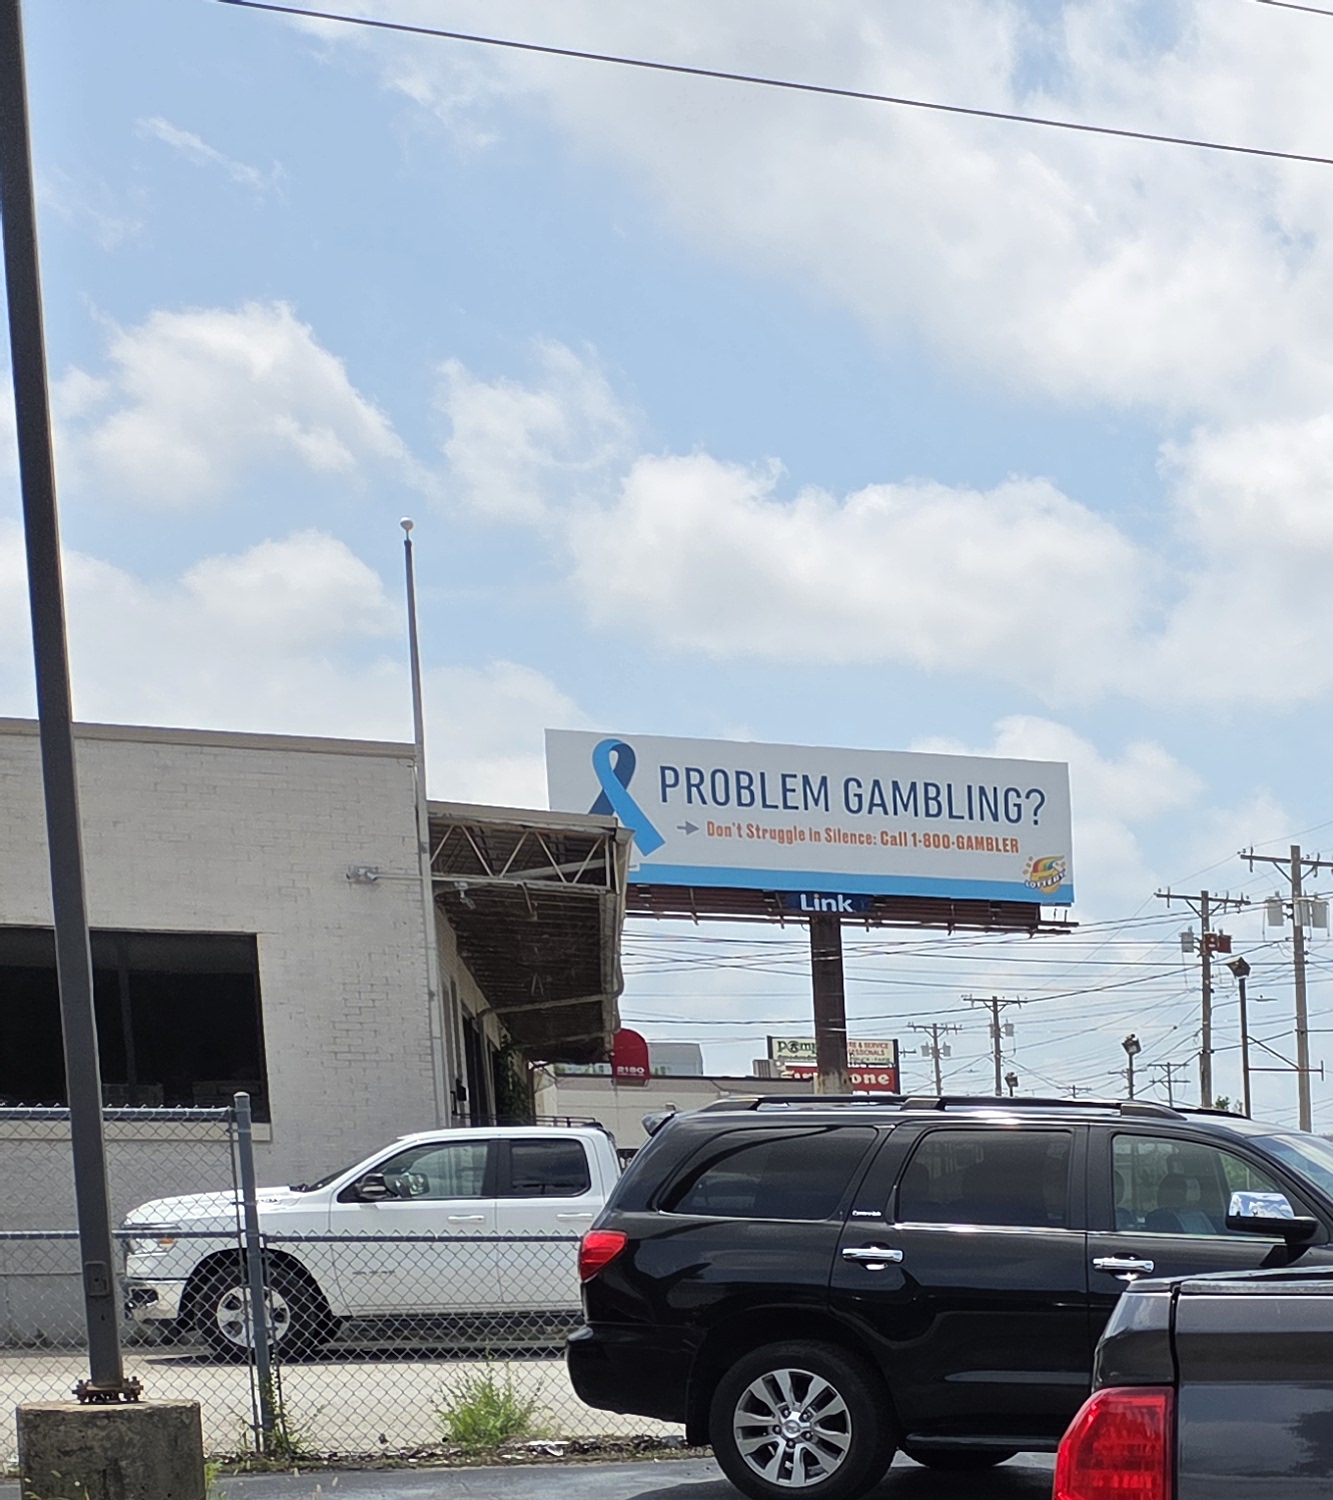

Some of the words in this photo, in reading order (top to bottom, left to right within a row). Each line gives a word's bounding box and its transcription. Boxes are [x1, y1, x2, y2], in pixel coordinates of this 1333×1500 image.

[659, 765, 830, 812] PROBLEM
[843, 777, 1046, 826] GAMBLING?
[707, 821, 743, 838] Don't
[746, 823, 805, 844] Struggle
[825, 828, 877, 845] Silence:
[881, 831, 907, 848] Call
[912, 832, 1019, 853] 1-800-GAMBLER
[800, 893, 854, 912] Link
